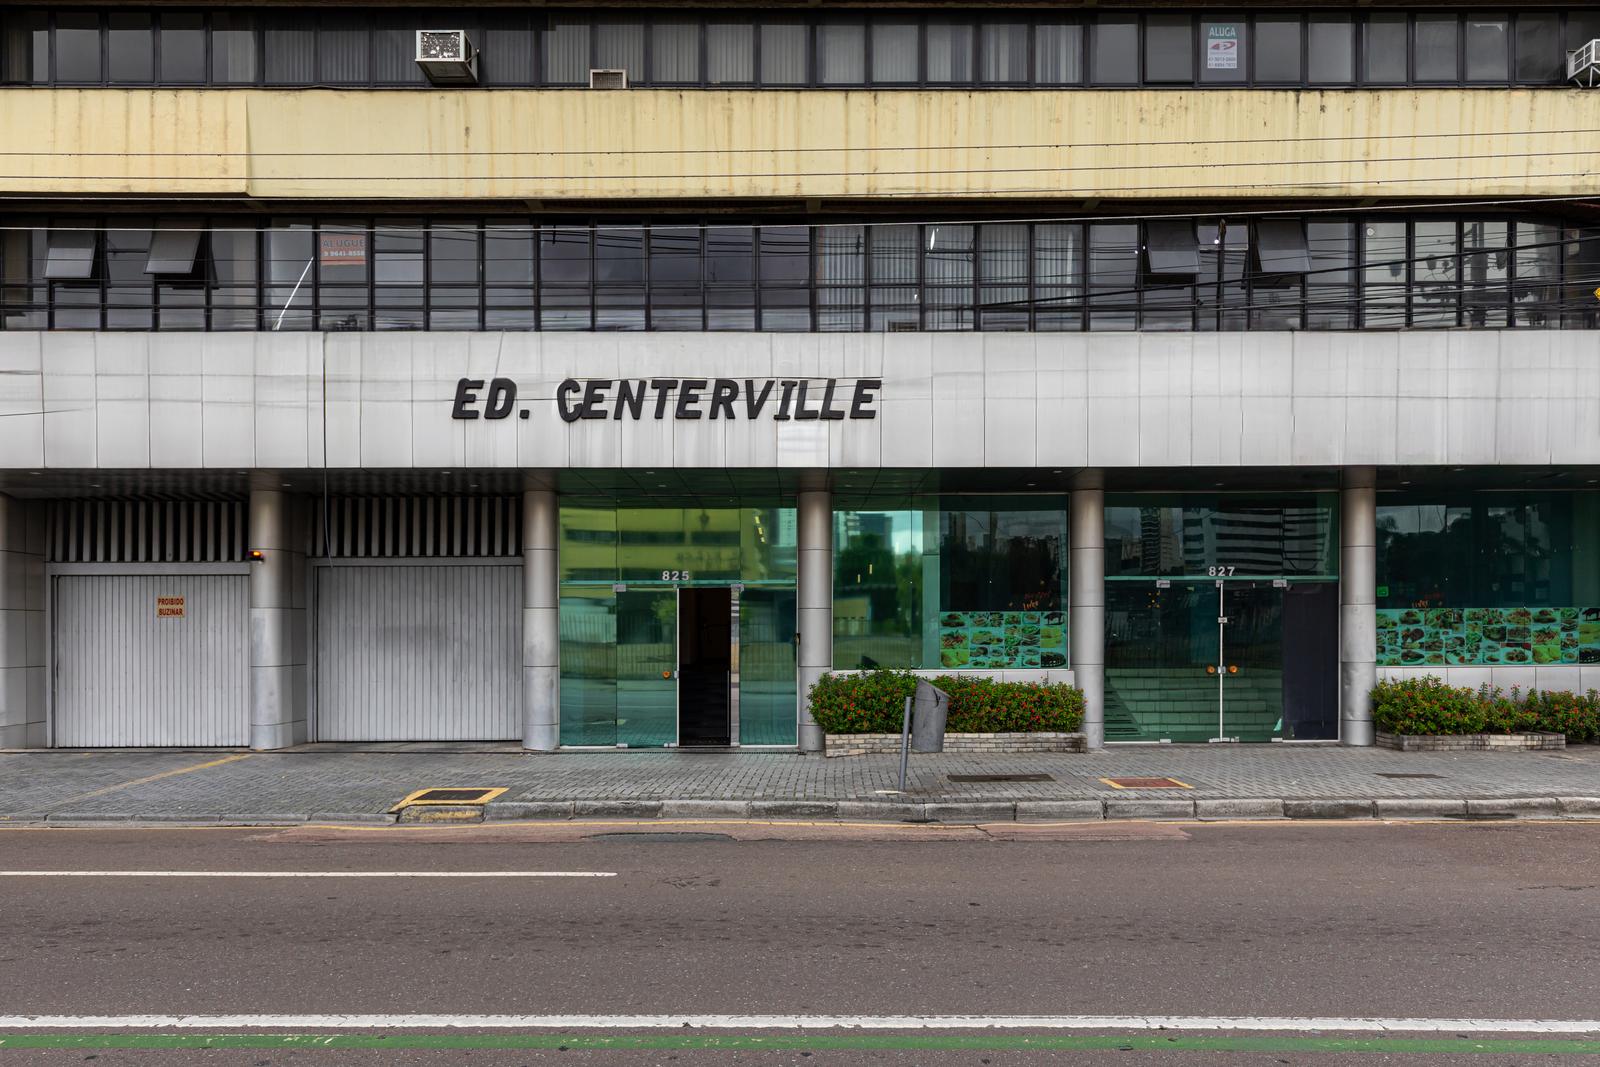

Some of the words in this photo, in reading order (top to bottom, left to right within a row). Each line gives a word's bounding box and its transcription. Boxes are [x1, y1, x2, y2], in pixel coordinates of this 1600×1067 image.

[1209, 27, 1236, 37] ALUGA
[322, 239, 365, 248] ALUGUE
[452, 378, 530, 420] ED.
[557, 378, 882, 423] CENTERVILLE
[662, 570, 689, 581] 825
[1208, 566, 1235, 577] 827
[159, 608, 183, 616] BUZINAR
